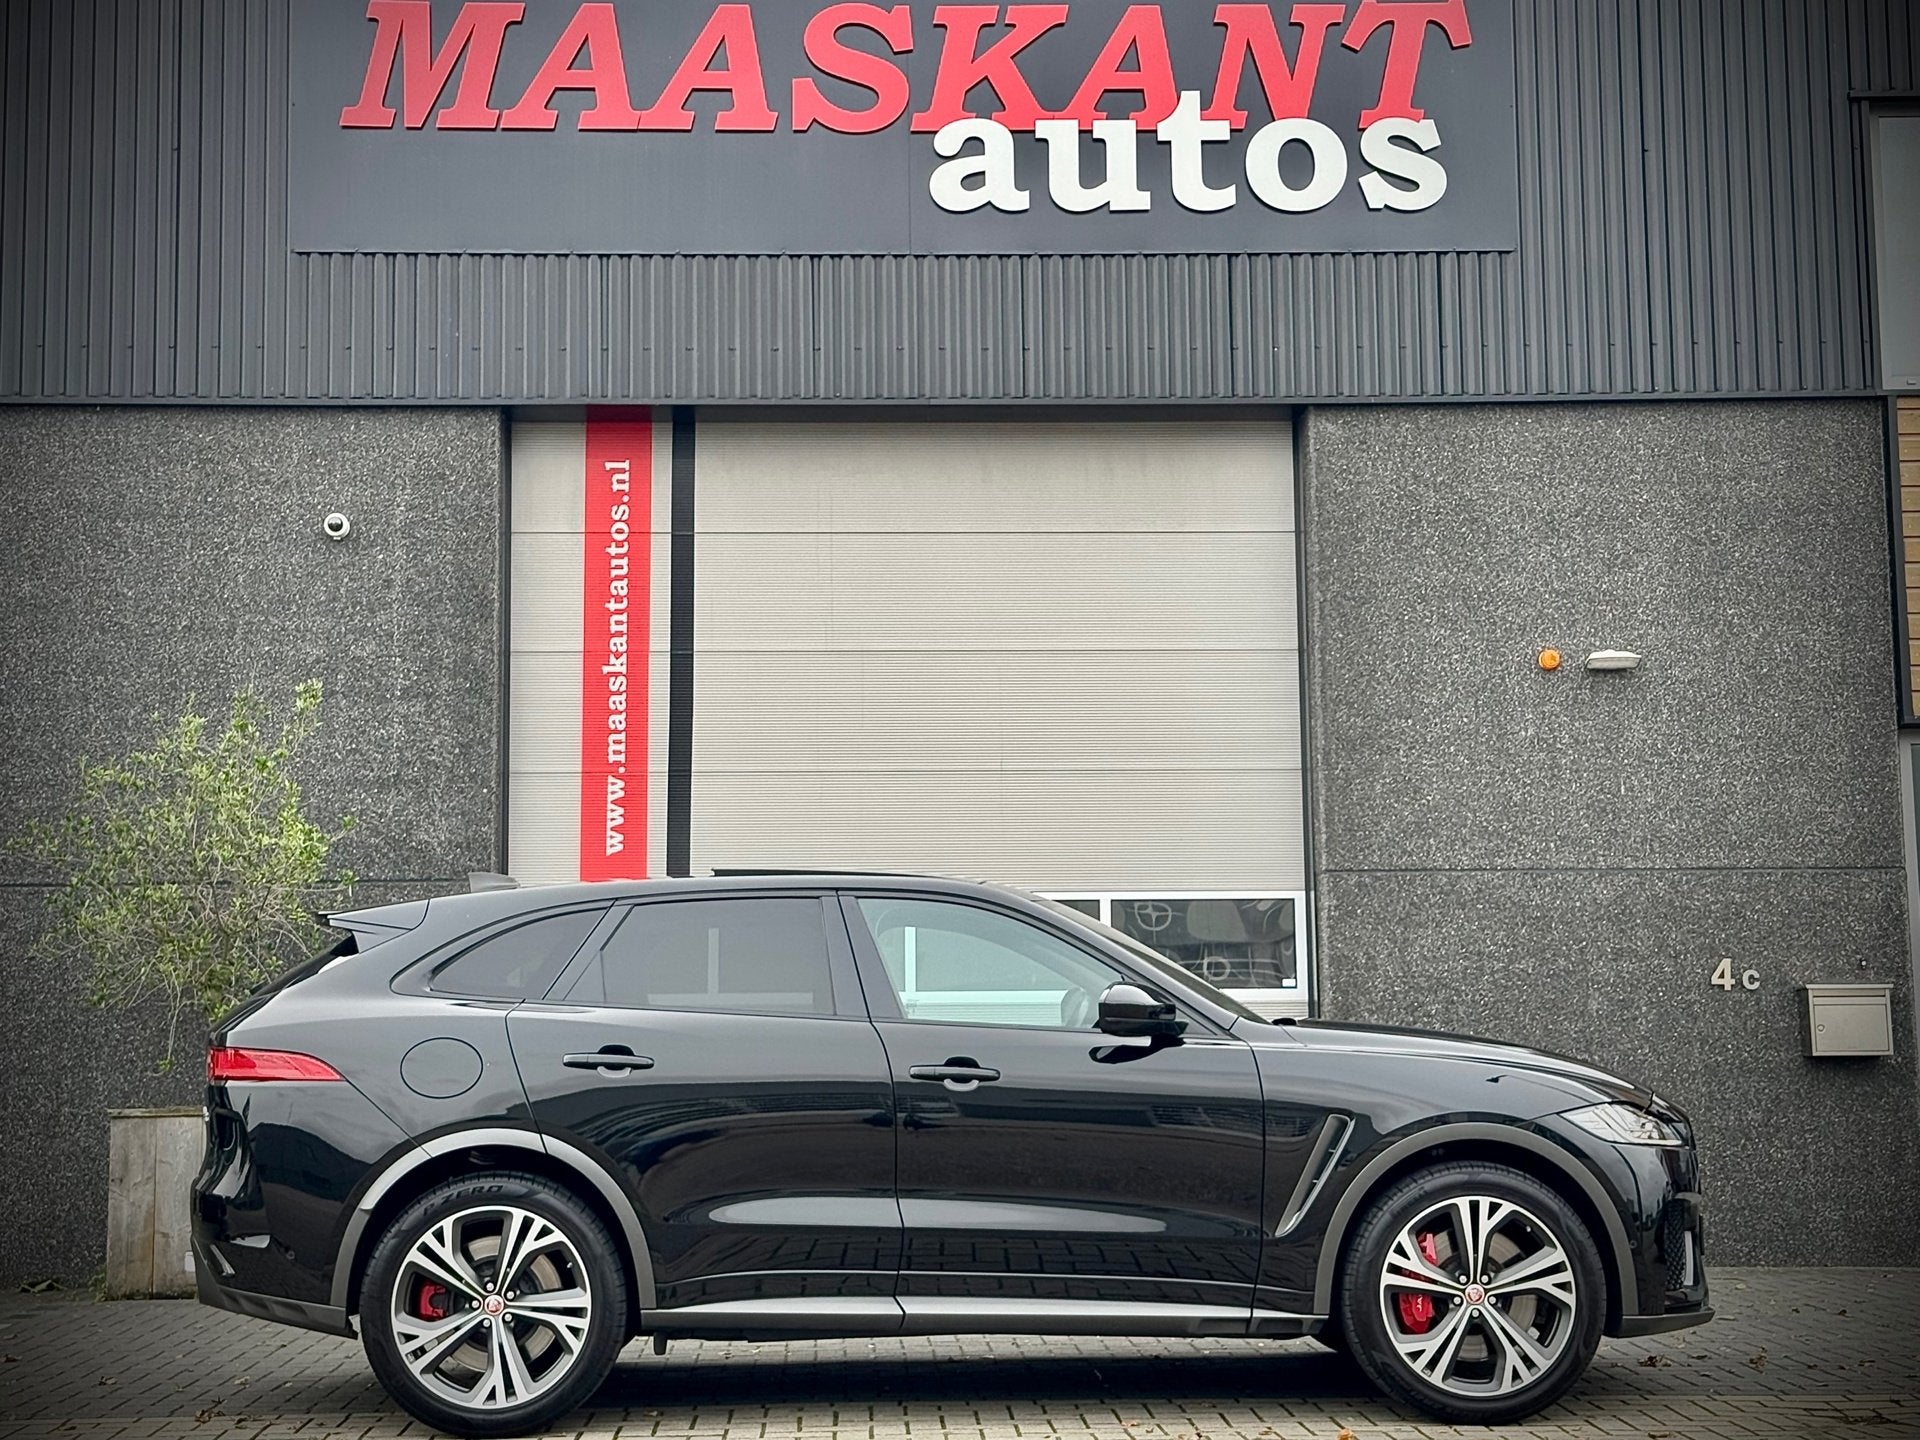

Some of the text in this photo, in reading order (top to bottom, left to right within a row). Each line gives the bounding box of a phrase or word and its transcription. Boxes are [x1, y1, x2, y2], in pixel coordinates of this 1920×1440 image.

[339, 0, 1472, 131] MAASKANT
[929, 90, 1448, 212] autos
[602, 458, 631, 856] www.maaskantautos.nl
